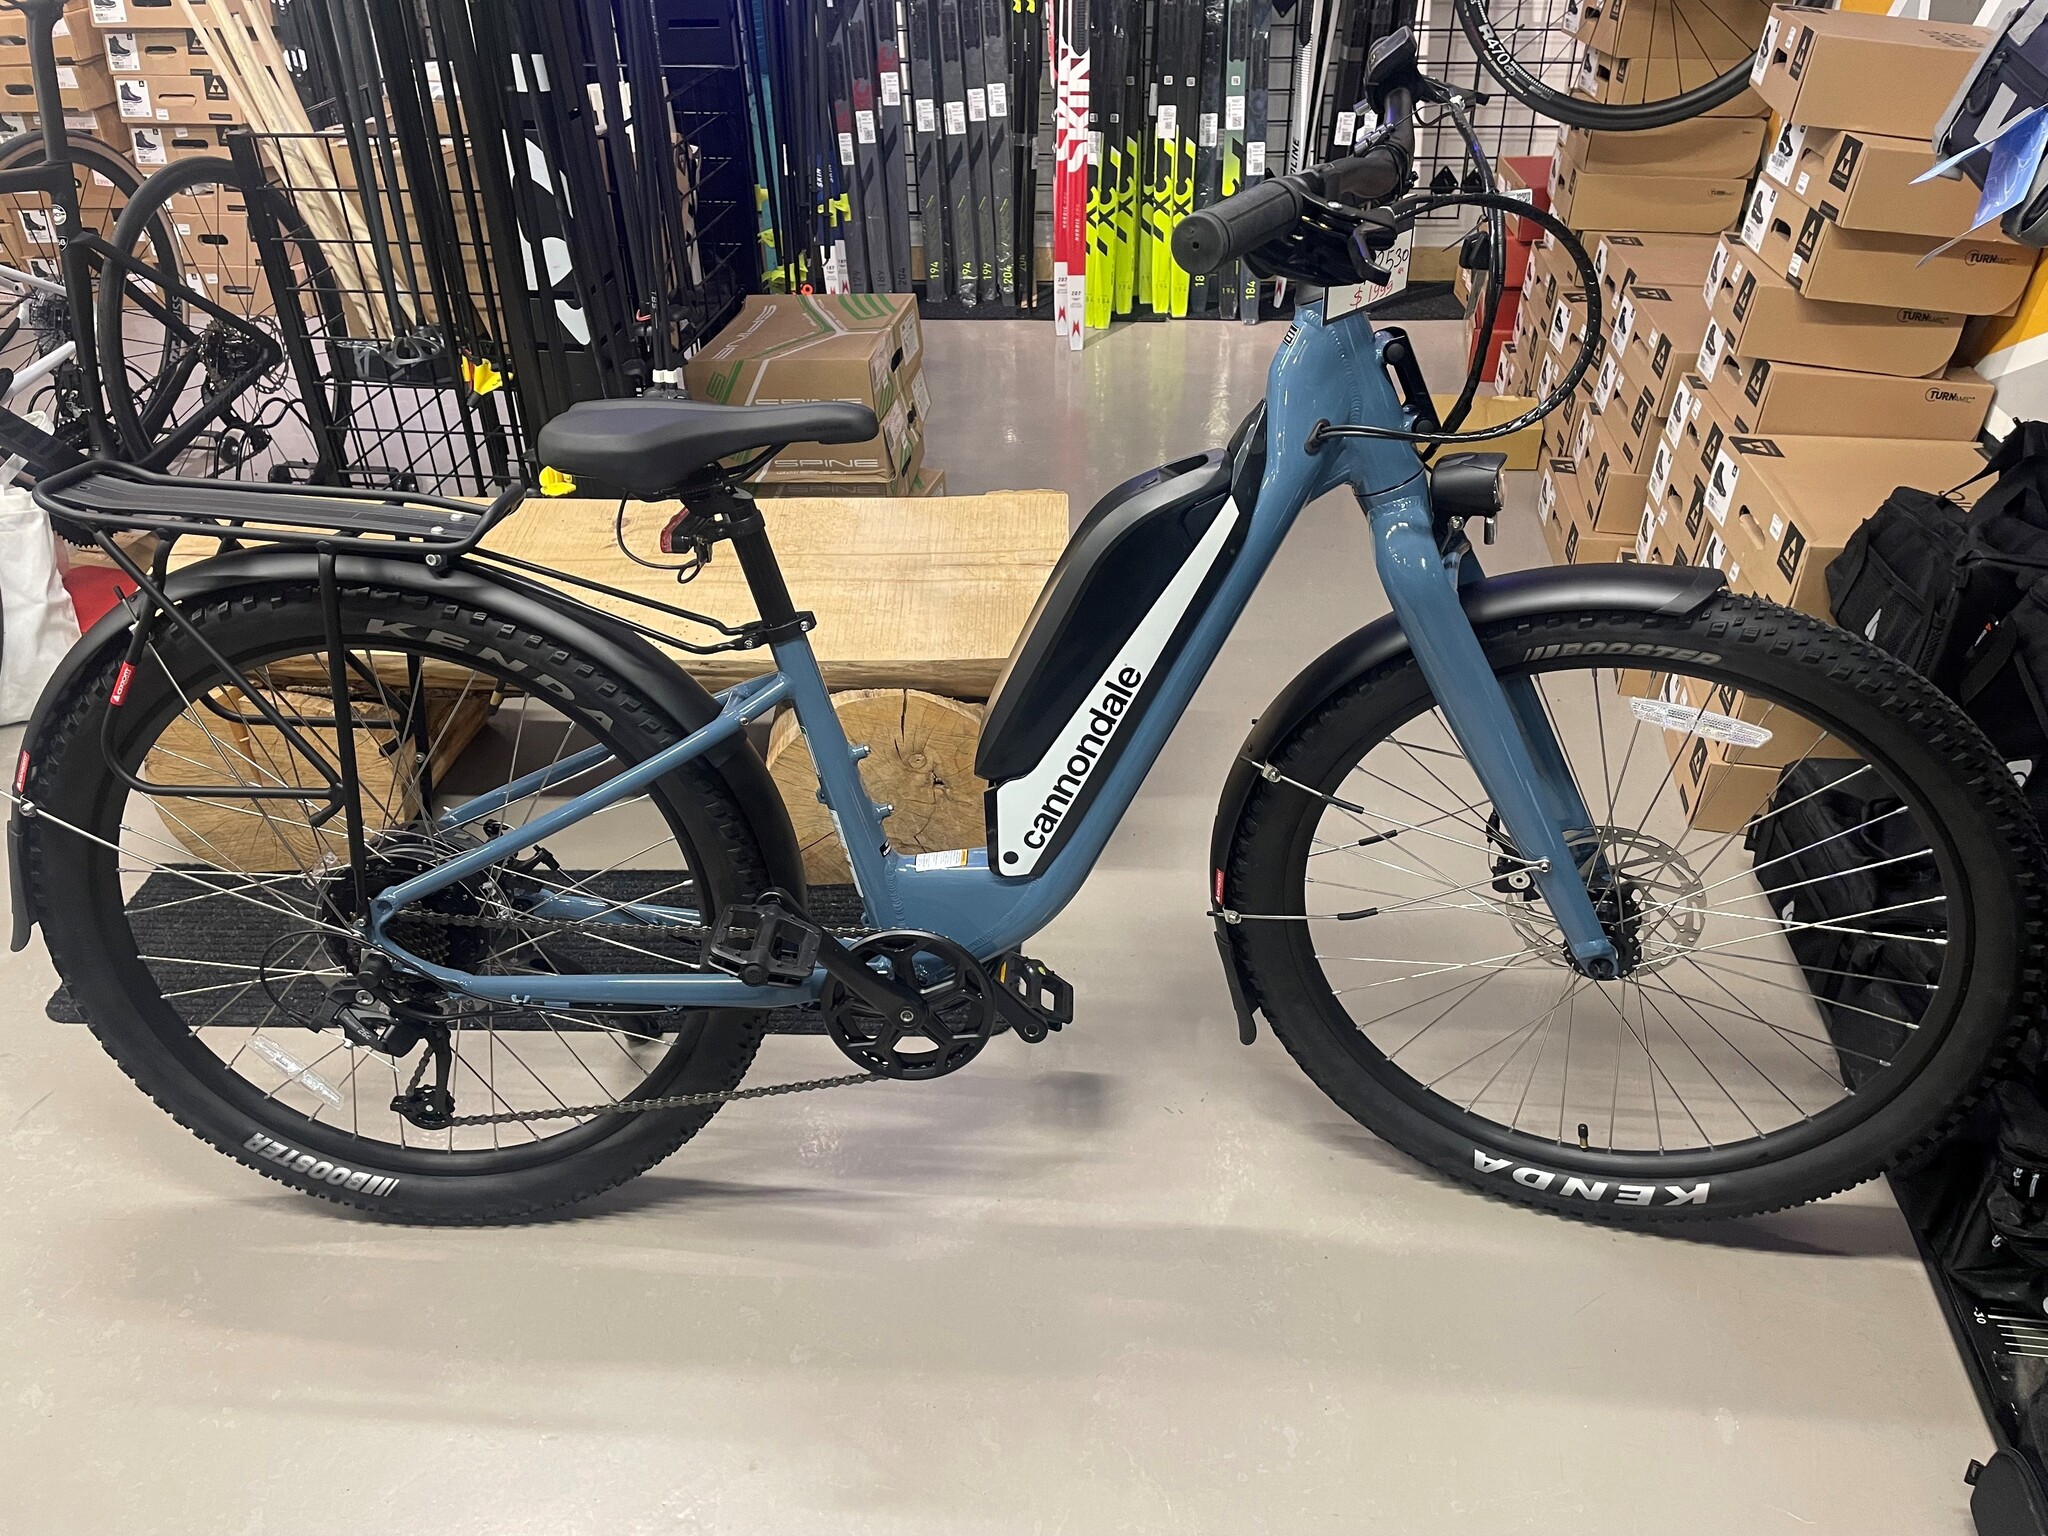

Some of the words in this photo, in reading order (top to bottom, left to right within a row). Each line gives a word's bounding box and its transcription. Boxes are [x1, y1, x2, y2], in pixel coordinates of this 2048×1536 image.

[1478, 23, 1511, 65] R470
[1068, 56, 1090, 173] SKIN
[930, 261, 940, 279] 194
[983, 262, 992, 280] 199
[1003, 264, 1013, 285] 204
[1245, 281, 1256, 299] 184
[711, 304, 777, 360] SPINE
[775, 459, 878, 468] SPINE
[787, 485, 879, 494] SPINE
[365, 618, 614, 732] KENDA
[1023, 666, 1142, 850] cannondale
[243, 1132, 373, 1191] BOOSTER
[1474, 1149, 1710, 1206] KENDA
